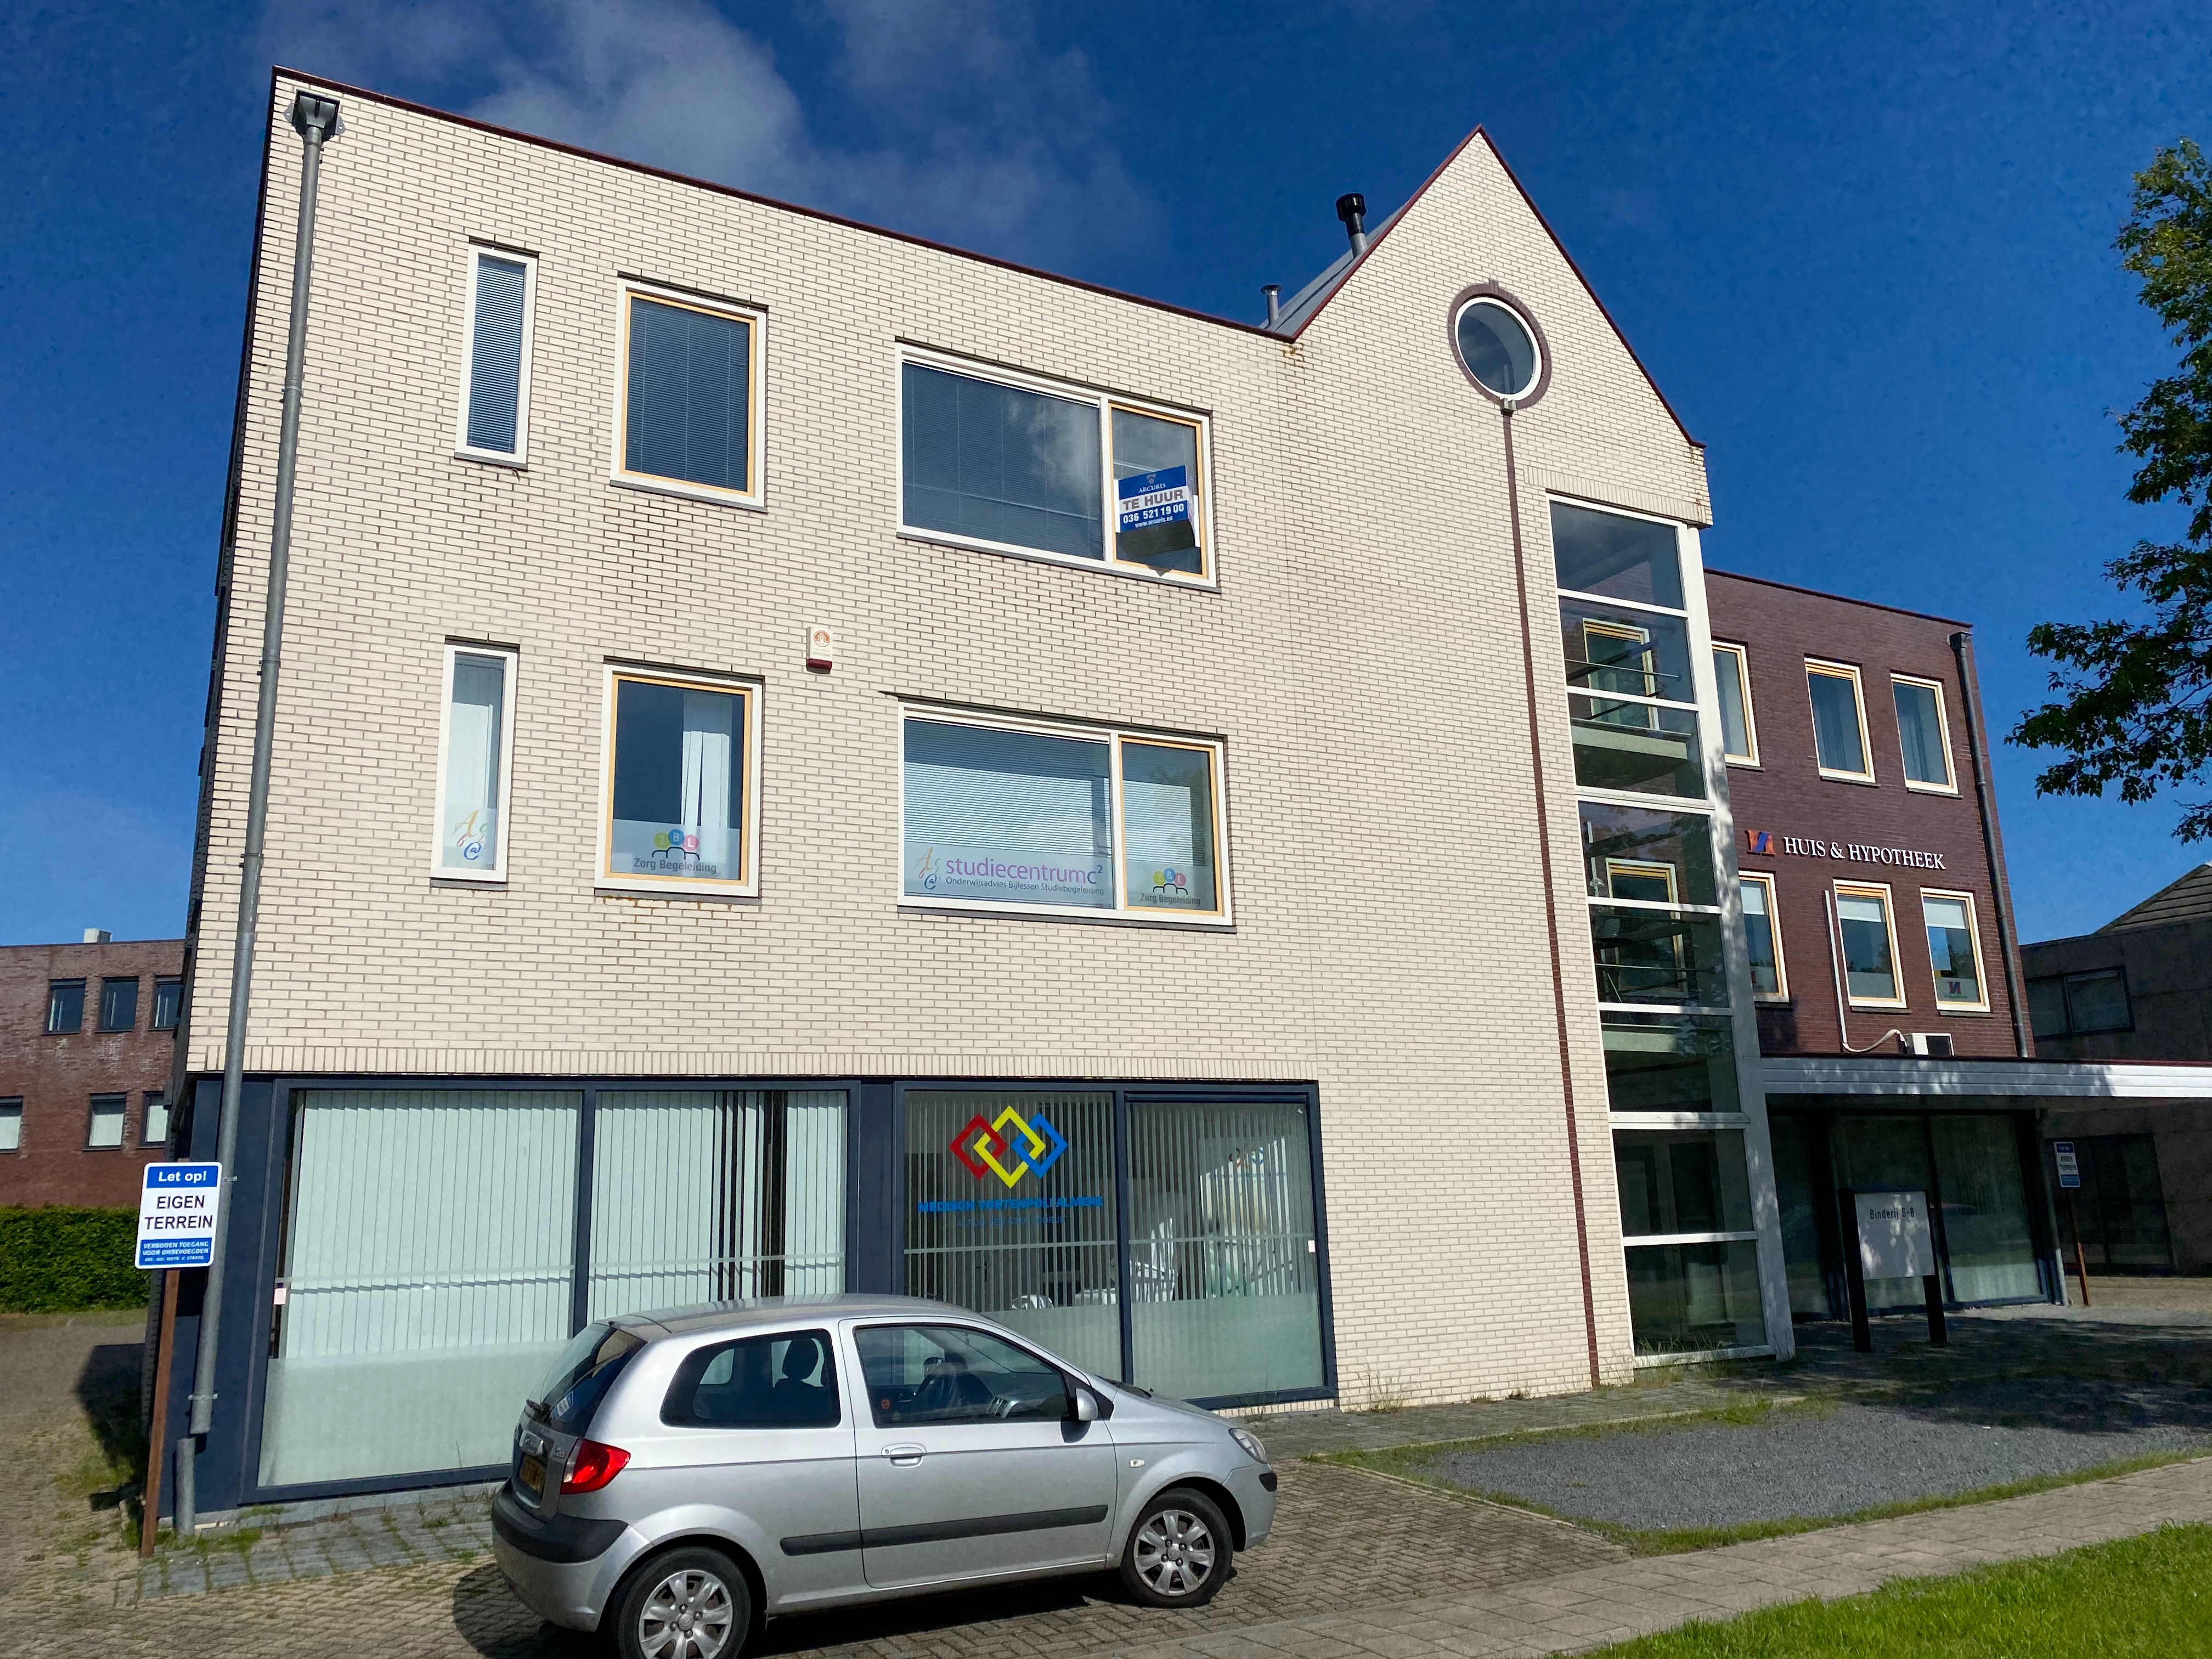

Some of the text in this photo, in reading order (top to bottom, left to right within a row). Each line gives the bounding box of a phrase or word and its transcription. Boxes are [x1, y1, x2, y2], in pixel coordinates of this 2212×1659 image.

[1138, 482, 1166, 493] ARCURIS
[1122, 489, 1183, 511] TE HUUR
[1122, 503, 1184, 524] 036 521 19 00
[1135, 516, 1173, 528] www.arcuris.eu
[1783, 836, 1946, 870] HUIS & HYPOTHEEK
[634, 857, 716, 874] Zorg Begeleiding
[946, 877, 1104, 896] Onderwijsadvies Bijlessen Studiebegeleiding
[1141, 893, 1200, 906] Zorg Begeleiding
[158, 1170, 207, 1184] Let op!
[156, 1195, 205, 1210] EIGEN
[1869, 1207, 1915, 1221] Binderij 6-8
[144, 1215, 213, 1230] TERREIN
